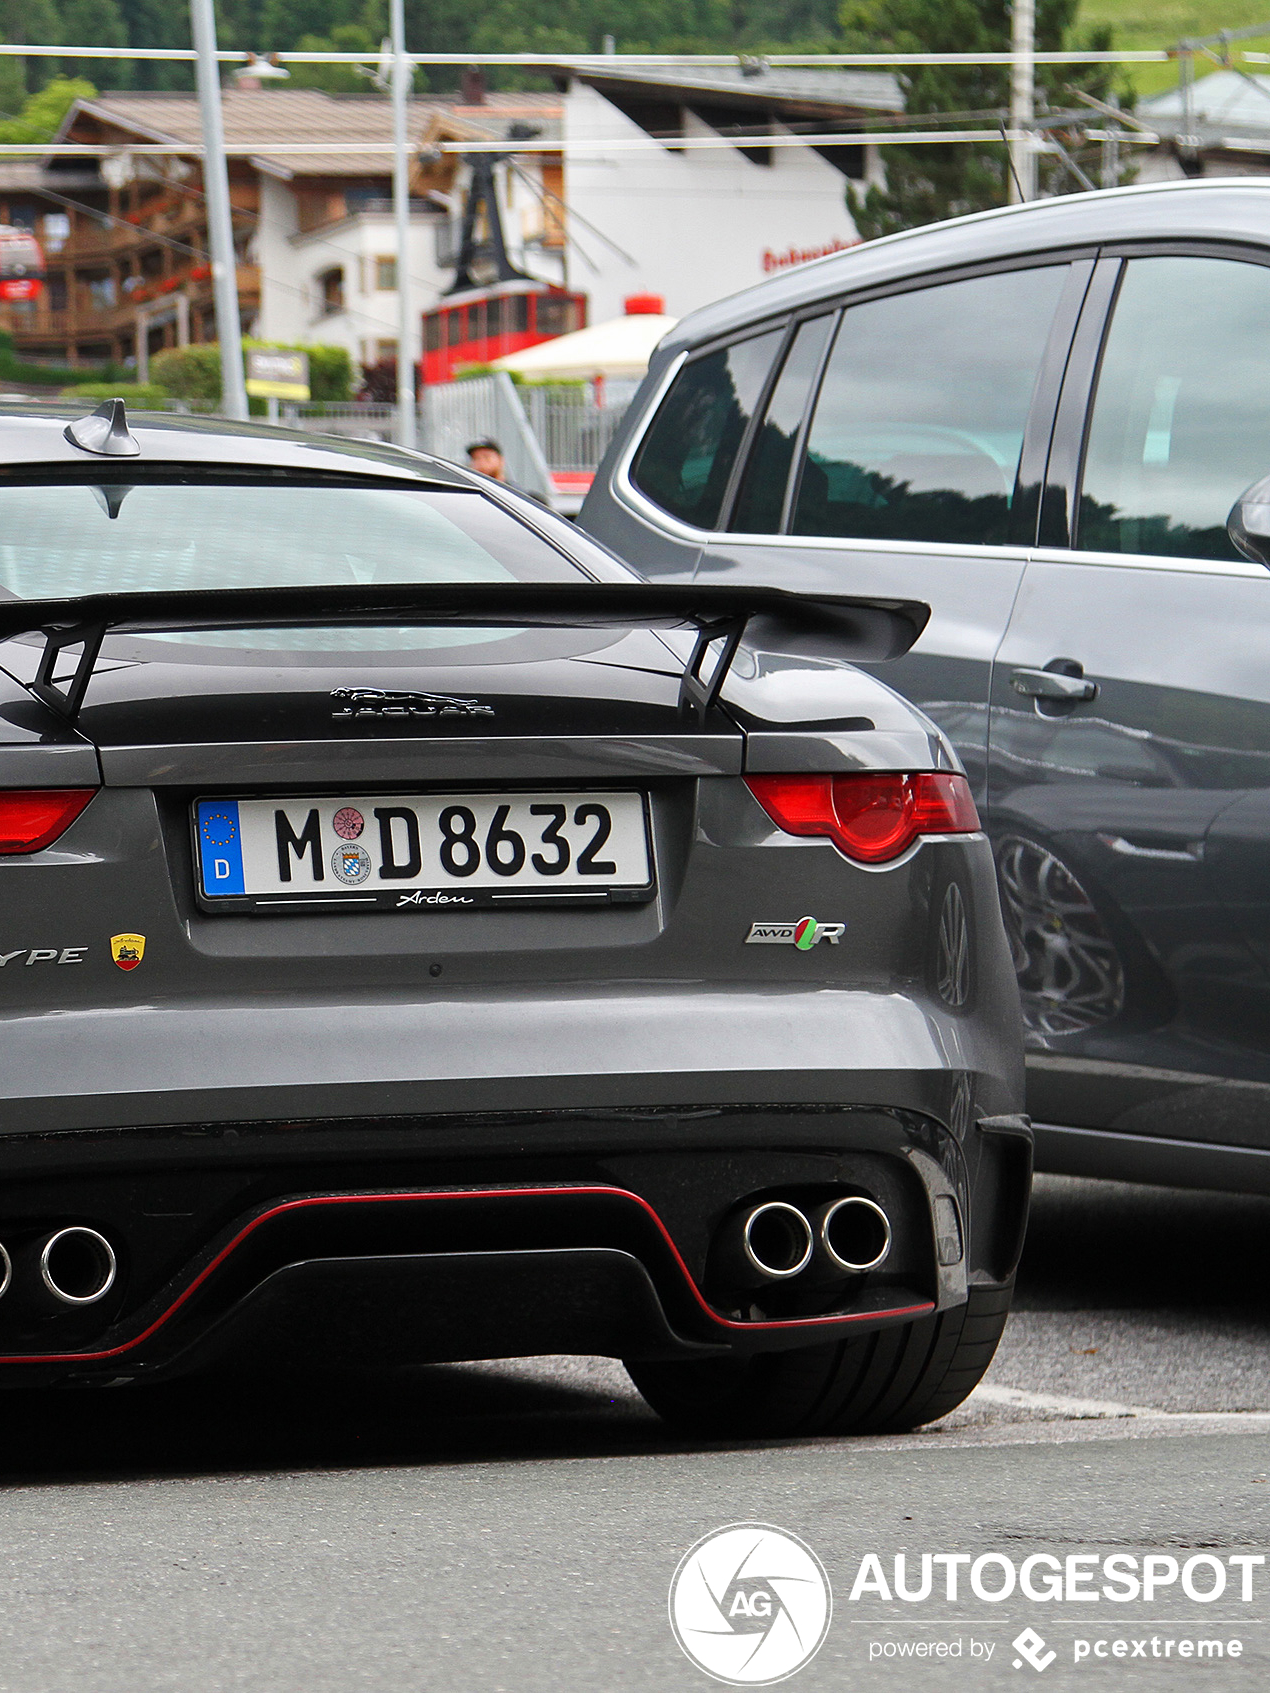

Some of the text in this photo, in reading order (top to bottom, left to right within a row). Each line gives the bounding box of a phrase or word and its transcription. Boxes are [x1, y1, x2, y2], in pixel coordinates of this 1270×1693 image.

[332, 706, 495, 718] JAGUAR
[274, 808, 325, 882] M
[374, 806, 422, 880] D
[438, 803, 617, 878] 8632
[214, 859, 230, 880] D
[395, 889, 474, 907] Arden
[752, 922, 846, 945] AWD R
